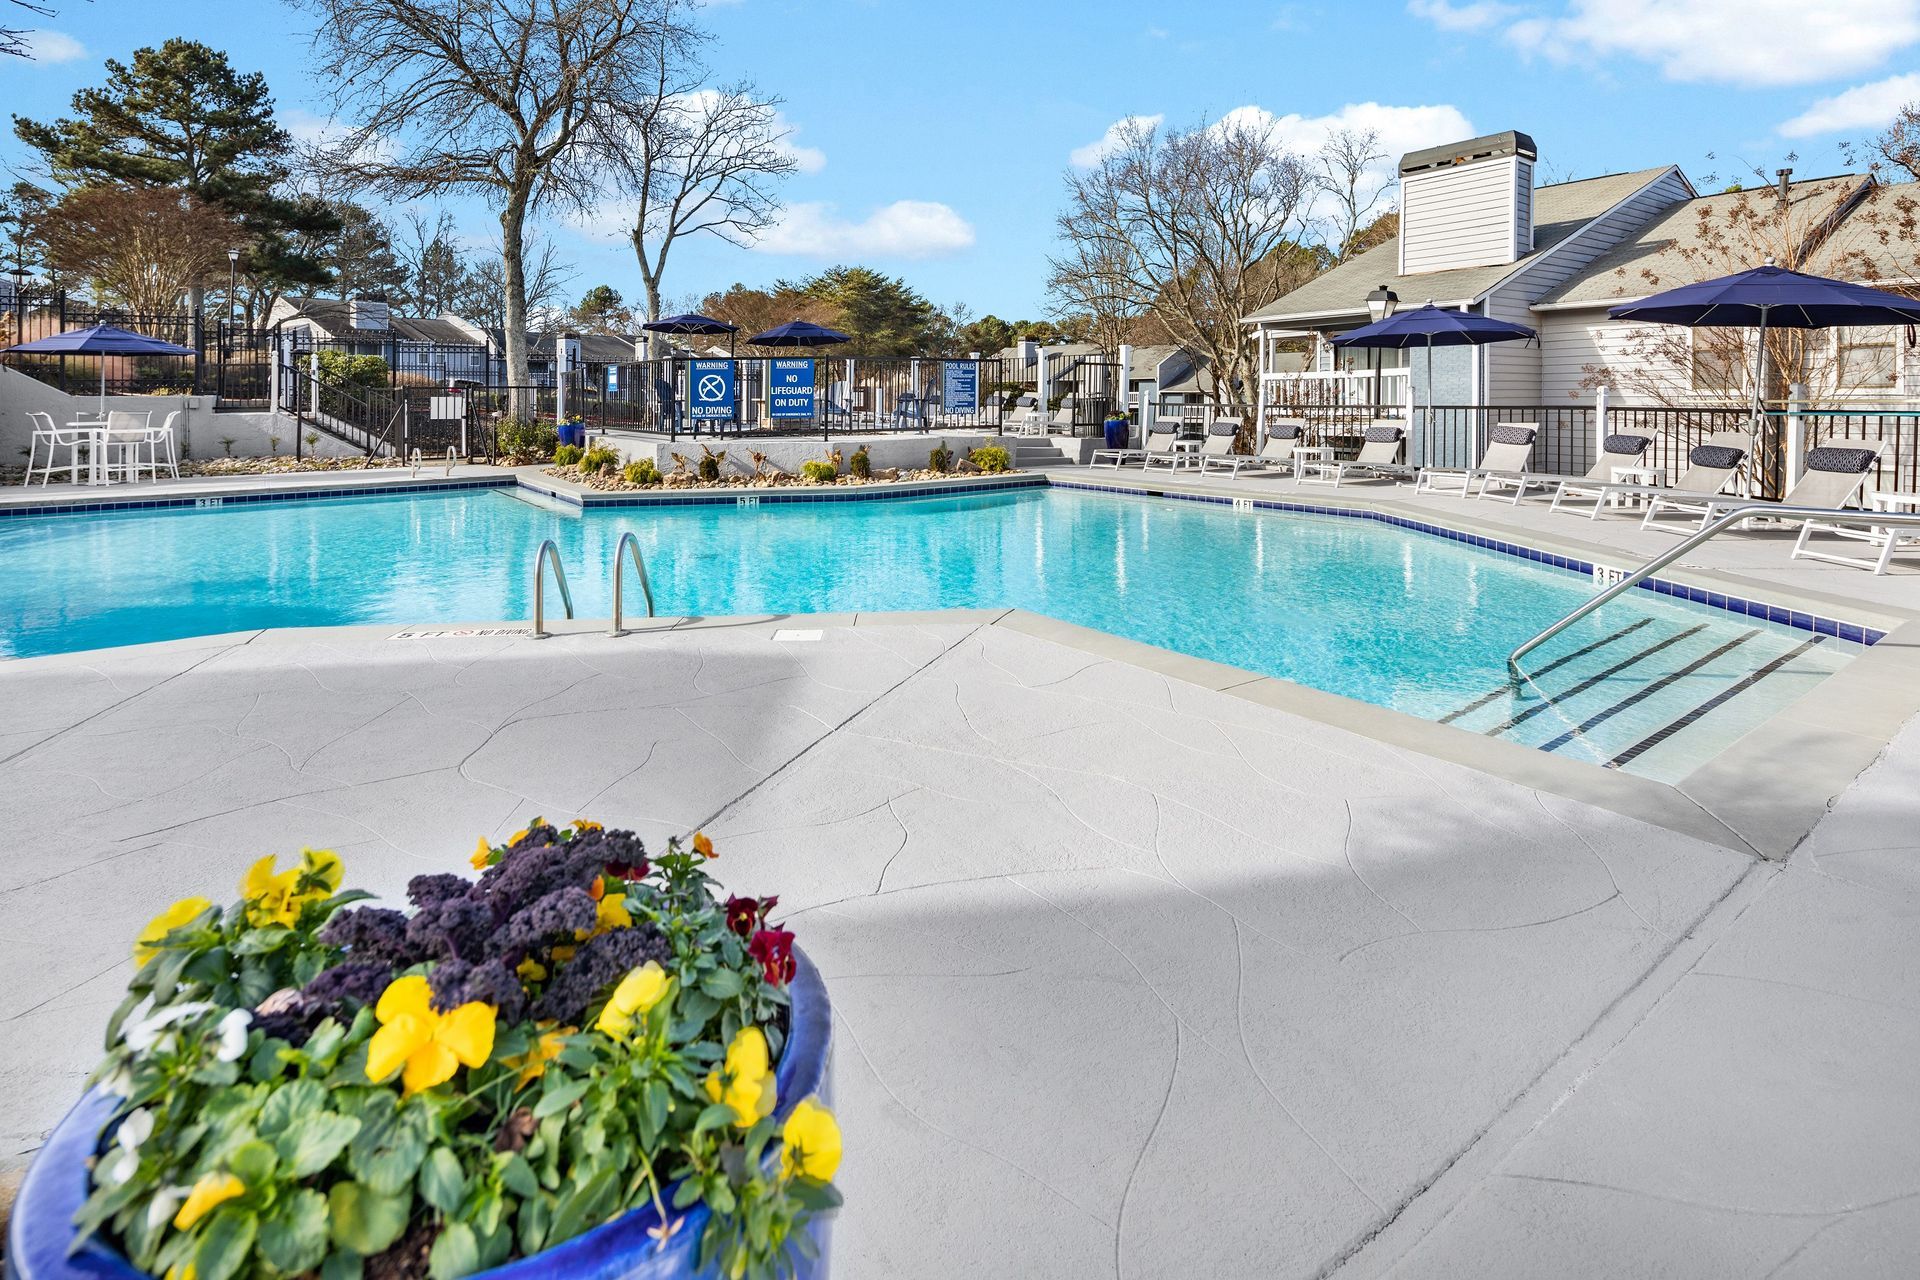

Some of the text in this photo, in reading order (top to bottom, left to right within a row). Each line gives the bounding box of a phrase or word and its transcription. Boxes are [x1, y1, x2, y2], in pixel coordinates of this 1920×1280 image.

[695, 361, 729, 369] WARNING
[775, 360, 809, 368] WARNING
[945, 362, 976, 370] POOL RULES
[786, 374, 798, 383] NO
[771, 386, 813, 395] LIFEGUARD
[774, 398, 809, 407] ON DUTY
[691, 406, 733, 415] NO DIVING
[945, 406, 975, 414] NO DIVING
[1609, 569, 1622, 582] FT
[494, 628, 532, 636] DIVING
